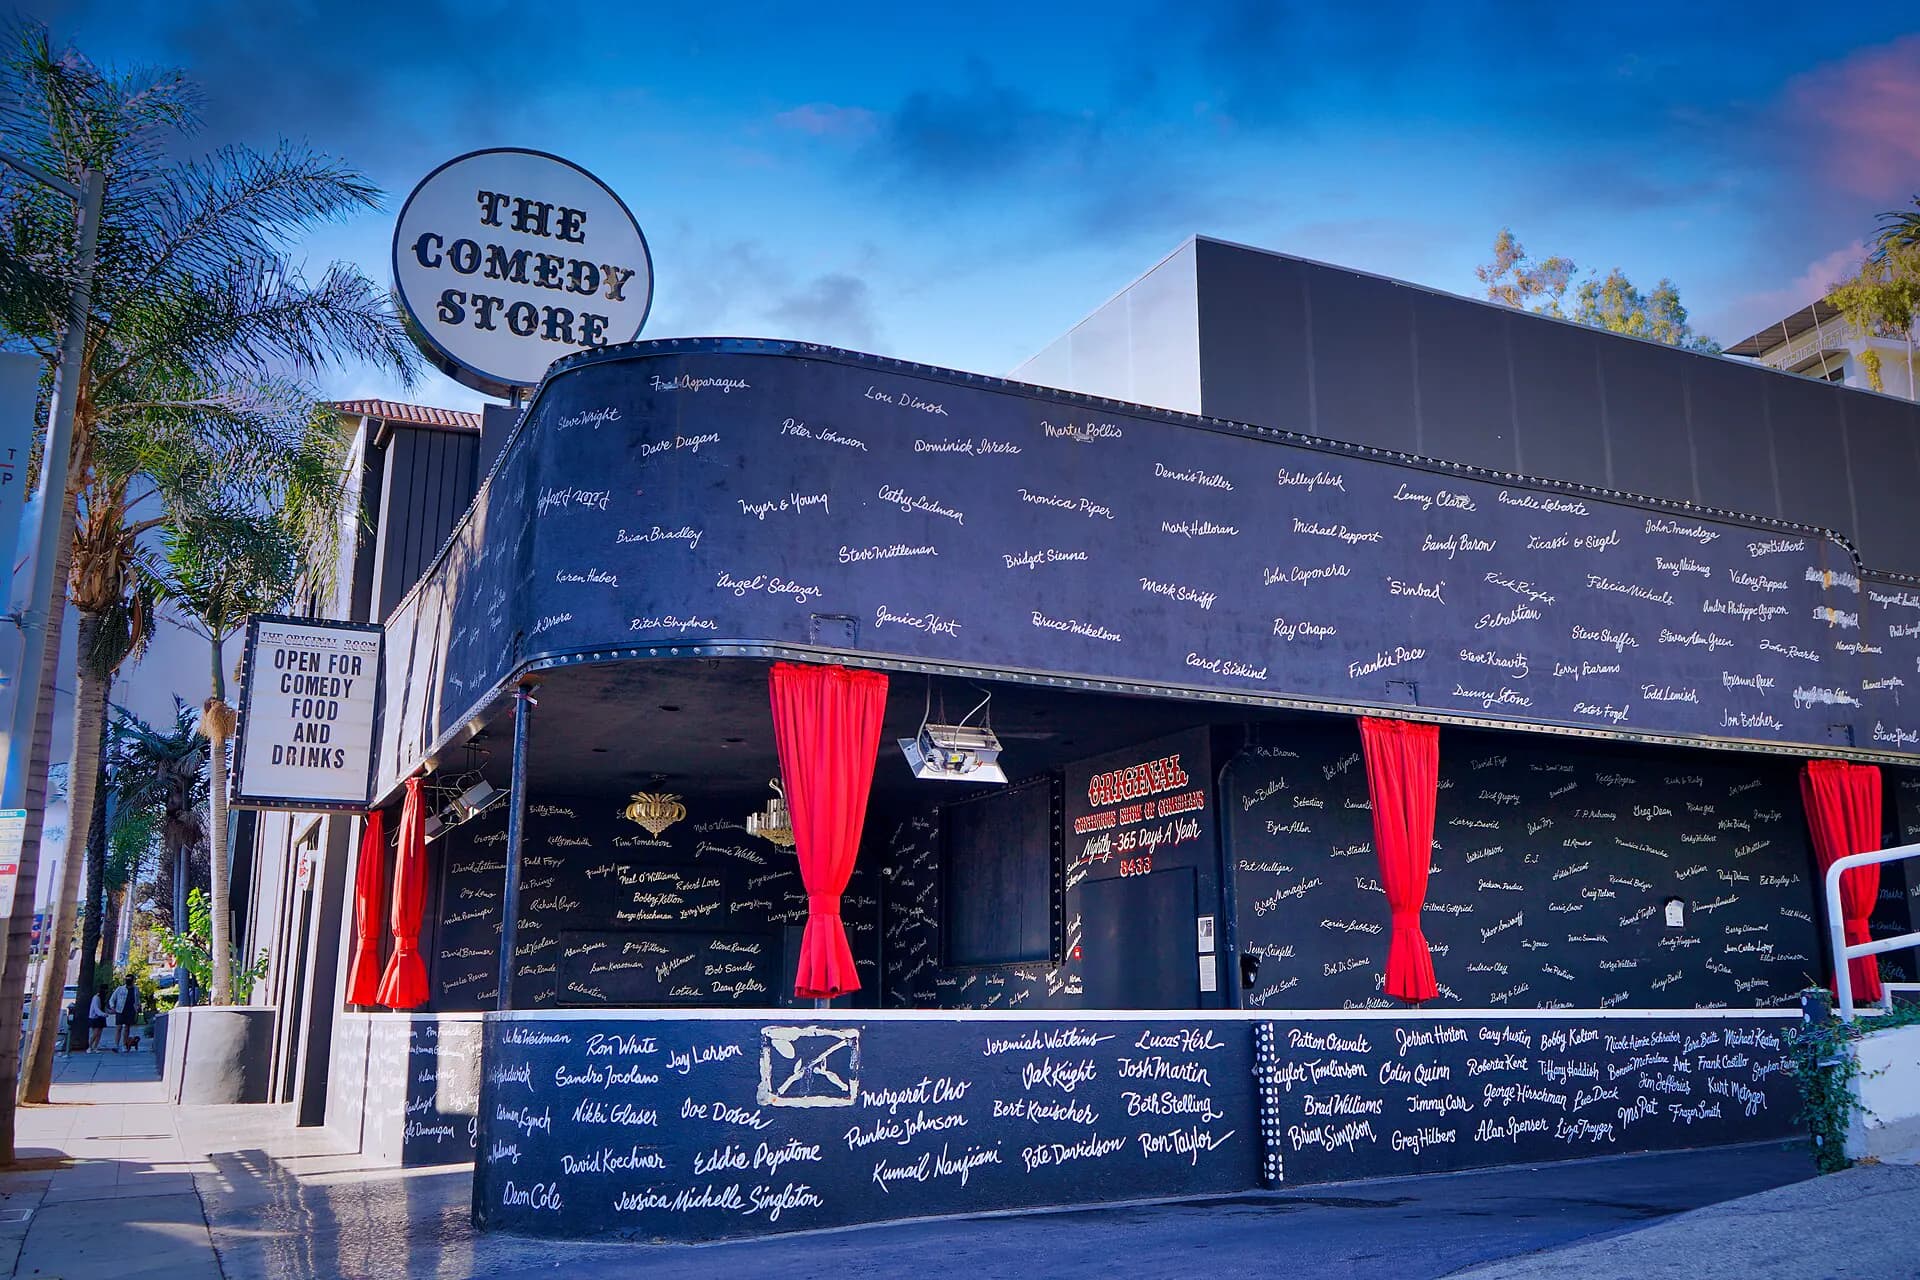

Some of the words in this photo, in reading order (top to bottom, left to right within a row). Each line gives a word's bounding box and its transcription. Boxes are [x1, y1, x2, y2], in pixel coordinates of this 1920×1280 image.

[478, 190, 586, 244] THE
[412, 233, 635, 301] COMEDY
[437, 289, 609, 348] STORE
[682, 375, 750, 392] Asparagus
[864, 386, 892, 402] Lou
[641, 442, 672, 456] Dave
[675, 432, 720, 452] Dugan
[781, 418, 811, 438] Peter
[815, 427, 868, 452] Johnson
[914, 439, 974, 456] Dominick
[1155, 463, 1196, 482] Dennis
[1196, 470, 1234, 490] Miller
[878, 484, 912, 512] Cathy
[912, 496, 965, 526] Ladman
[1018, 489, 1078, 509] Monica
[1080, 498, 1116, 520] Piper
[616, 530, 649, 543] Brian
[651, 526, 703, 549] Bradley
[1162, 521, 1192, 538] Mark
[1293, 518, 1337, 536] Michael
[1645, 521, 1671, 535] John
[1422, 534, 1457, 560] Sandy
[1002, 553, 1045, 569] Bridget
[556, 570, 586, 582] Karen
[586, 569, 619, 588] Haber
[1264, 567, 1288, 586] John
[768, 578, 822, 603] Salazar
[1140, 578, 1176, 600] Mark
[1176, 587, 1217, 610] Schiff
[876, 606, 925, 628] Janice
[924, 614, 962, 638] Hart
[1032, 611, 1070, 631] Bruce
[1274, 618, 1296, 640] Ray
[274, 649, 321, 673] OPEN
[328, 654, 362, 676] FOR
[1186, 652, 1220, 672] Carol
[1348, 652, 1396, 679] Frankie
[1396, 646, 1425, 662] Pace
[1460, 650, 1488, 662] Steve
[281, 673, 353, 698] COMEDY
[291, 698, 339, 720] FOOD
[293, 722, 330, 744] AND
[272, 744, 344, 769] DRINKS
[1088, 754, 1189, 806] ORIGINAL
[1144, 802, 1156, 820] OF
[1140, 826, 1162, 854] Days
[1162, 822, 1172, 843] A
[1175, 818, 1201, 844] Year
[1120, 854, 1152, 877] 8433
[586, 1034, 612, 1056] Ron
[610, 1034, 658, 1056] White
[983, 1030, 1043, 1056] Jeremiah
[1044, 1027, 1116, 1048] Watkins
[1135, 1031, 1180, 1049] Lucas
[1288, 1029, 1326, 1050] Patton
[1327, 1033, 1372, 1053] Oswalt
[1434, 1024, 1468, 1043] Horton
[1479, 1027, 1501, 1045] Gary
[1502, 1025, 1531, 1048] Austin
[1540, 1030, 1567, 1052] Bobby
[1568, 1028, 1599, 1046] Kelton
[1724, 1028, 1754, 1048] Michael
[666, 1051, 690, 1074] Jay
[692, 1044, 742, 1064] Larson
[1118, 1057, 1153, 1078] Josh
[1152, 1056, 1211, 1087] Martin
[1504, 1054, 1528, 1070] Kent
[1673, 1056, 1691, 1073] Ant
[1698, 1055, 1721, 1070] Frank
[1722, 1053, 1749, 1069] Castillo
[555, 1066, 602, 1087] Sandro
[1052, 1059, 1097, 1092] Knight
[1273, 1058, 1307, 1092] aylor
[1303, 1058, 1367, 1084] Tomlinson
[1380, 1061, 1411, 1084] Colin
[1414, 1060, 1450, 1086] Quinn
[1538, 1060, 1567, 1085] Tiffany
[1567, 1060, 1599, 1080] Haddish
[861, 1077, 932, 1114] Margaret
[933, 1077, 971, 1101] Cho
[1121, 1092, 1160, 1116] Beth
[1161, 1091, 1223, 1122] Stelling
[1304, 1095, 1334, 1116] Brad
[1334, 1095, 1383, 1114] Williams
[1407, 1095, 1445, 1117] Jimmy
[1446, 1095, 1474, 1112] Carr
[1483, 1084, 1515, 1107] George
[1516, 1084, 1567, 1111] Hirschman
[1637, 1096, 1658, 1118] Pat
[1708, 1077, 1729, 1097] Kurt
[1731, 1081, 1767, 1117] Metzger
[572, 1098, 607, 1121] Nikki
[610, 1104, 658, 1126] Glaser
[712, 1102, 774, 1129] Dosch
[993, 1099, 1024, 1118] Bert
[1027, 1100, 1099, 1124] Kreischer
[844, 1119, 904, 1150] Punkie
[898, 1111, 968, 1145] Johnson
[1288, 1122, 1325, 1151] Brian
[1325, 1119, 1377, 1152] Simpson
[1392, 1130, 1419, 1155] Greg
[1418, 1128, 1456, 1147] Hilbers
[1474, 1119, 1505, 1142] Alan
[694, 1152, 749, 1175] Eddie
[753, 1138, 822, 1175] Pepitone
[1022, 1144, 1051, 1173] Pete
[1053, 1133, 1127, 1165] Davidson
[1138, 1133, 1172, 1158] Ron
[1171, 1126, 1235, 1166] Taylor
[560, 1152, 600, 1175] David
[602, 1148, 666, 1173] Koechner
[873, 1153, 929, 1193] Kumail
[934, 1141, 1002, 1189] Nanjiani
[531, 1183, 562, 1211] Cole
[614, 1187, 673, 1211] Jessica
[671, 1184, 744, 1212] Michelle
[742, 1183, 823, 1222] Singleton
